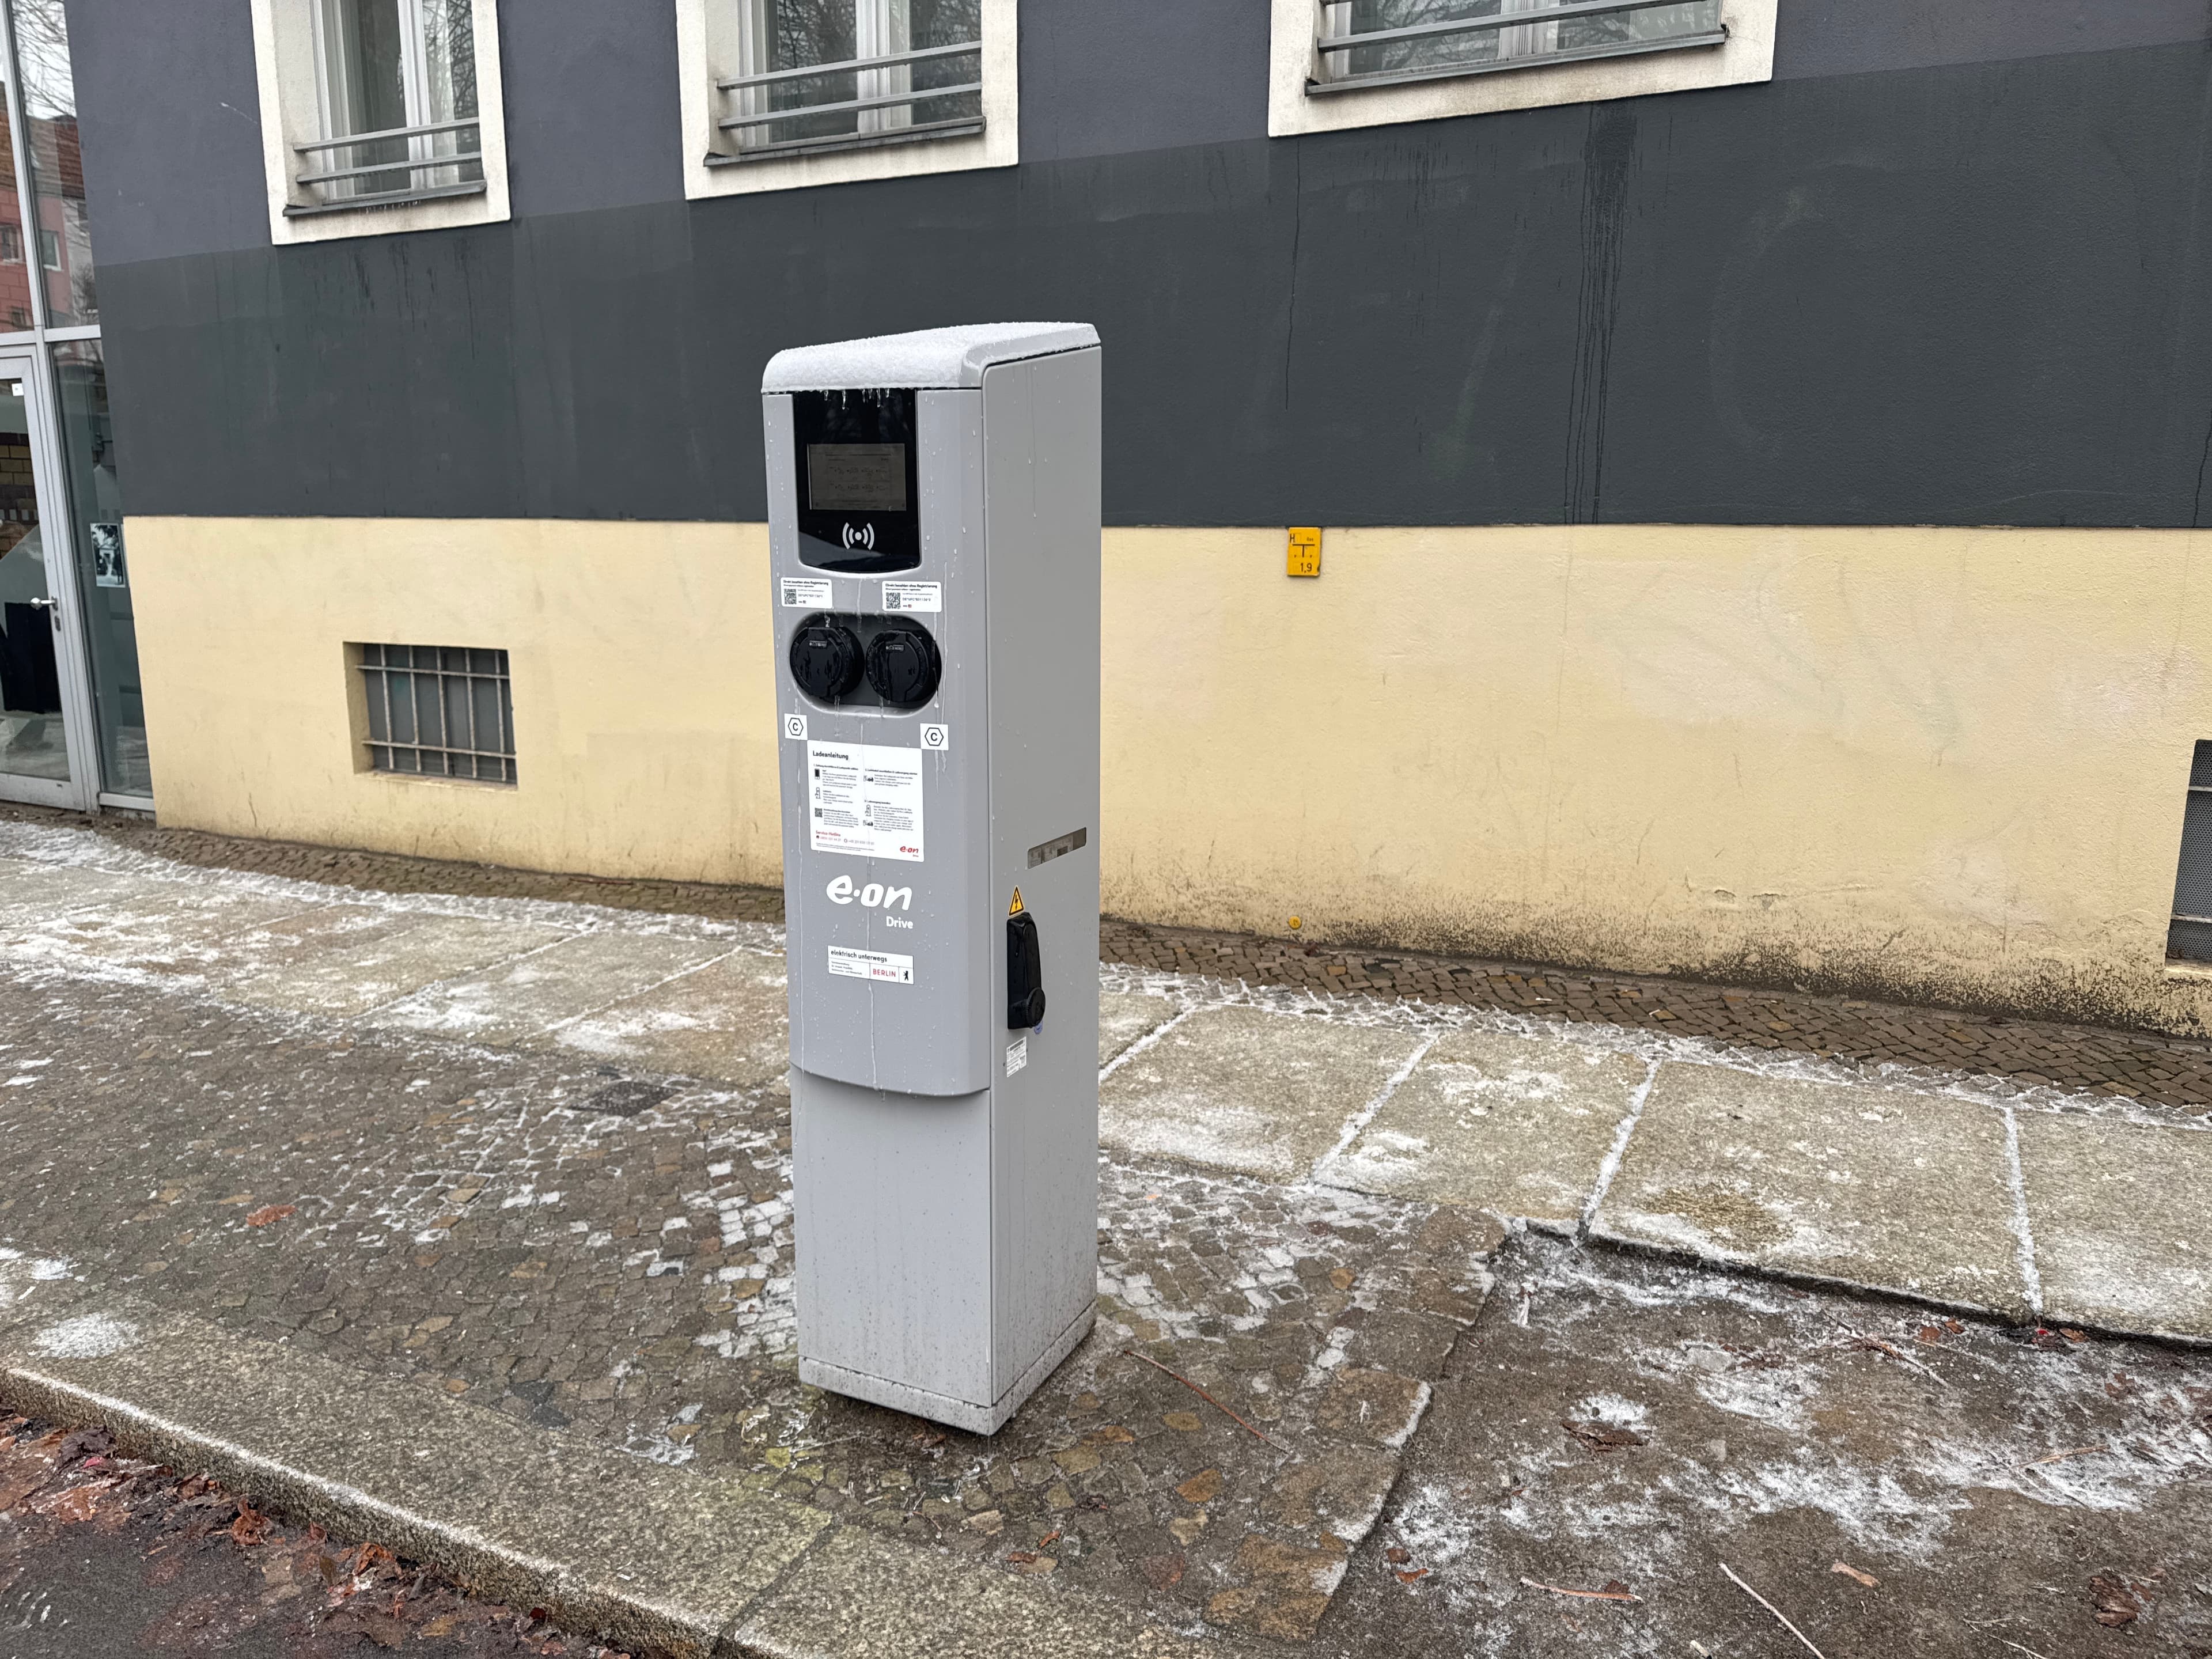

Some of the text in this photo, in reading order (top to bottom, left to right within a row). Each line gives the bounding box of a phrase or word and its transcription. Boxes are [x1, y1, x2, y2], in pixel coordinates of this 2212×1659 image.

[1290, 533, 1295, 543] H
[1300, 562, 1312, 574] 1,9
[792, 722, 798, 732] C
[930, 732, 938, 741] C
[812, 750, 849, 761] Ladeanleitung
[885, 915, 914, 929] Drive
[831, 949, 888, 963] elektrisch unterwegs
[872, 968, 896, 978] BERLIN
